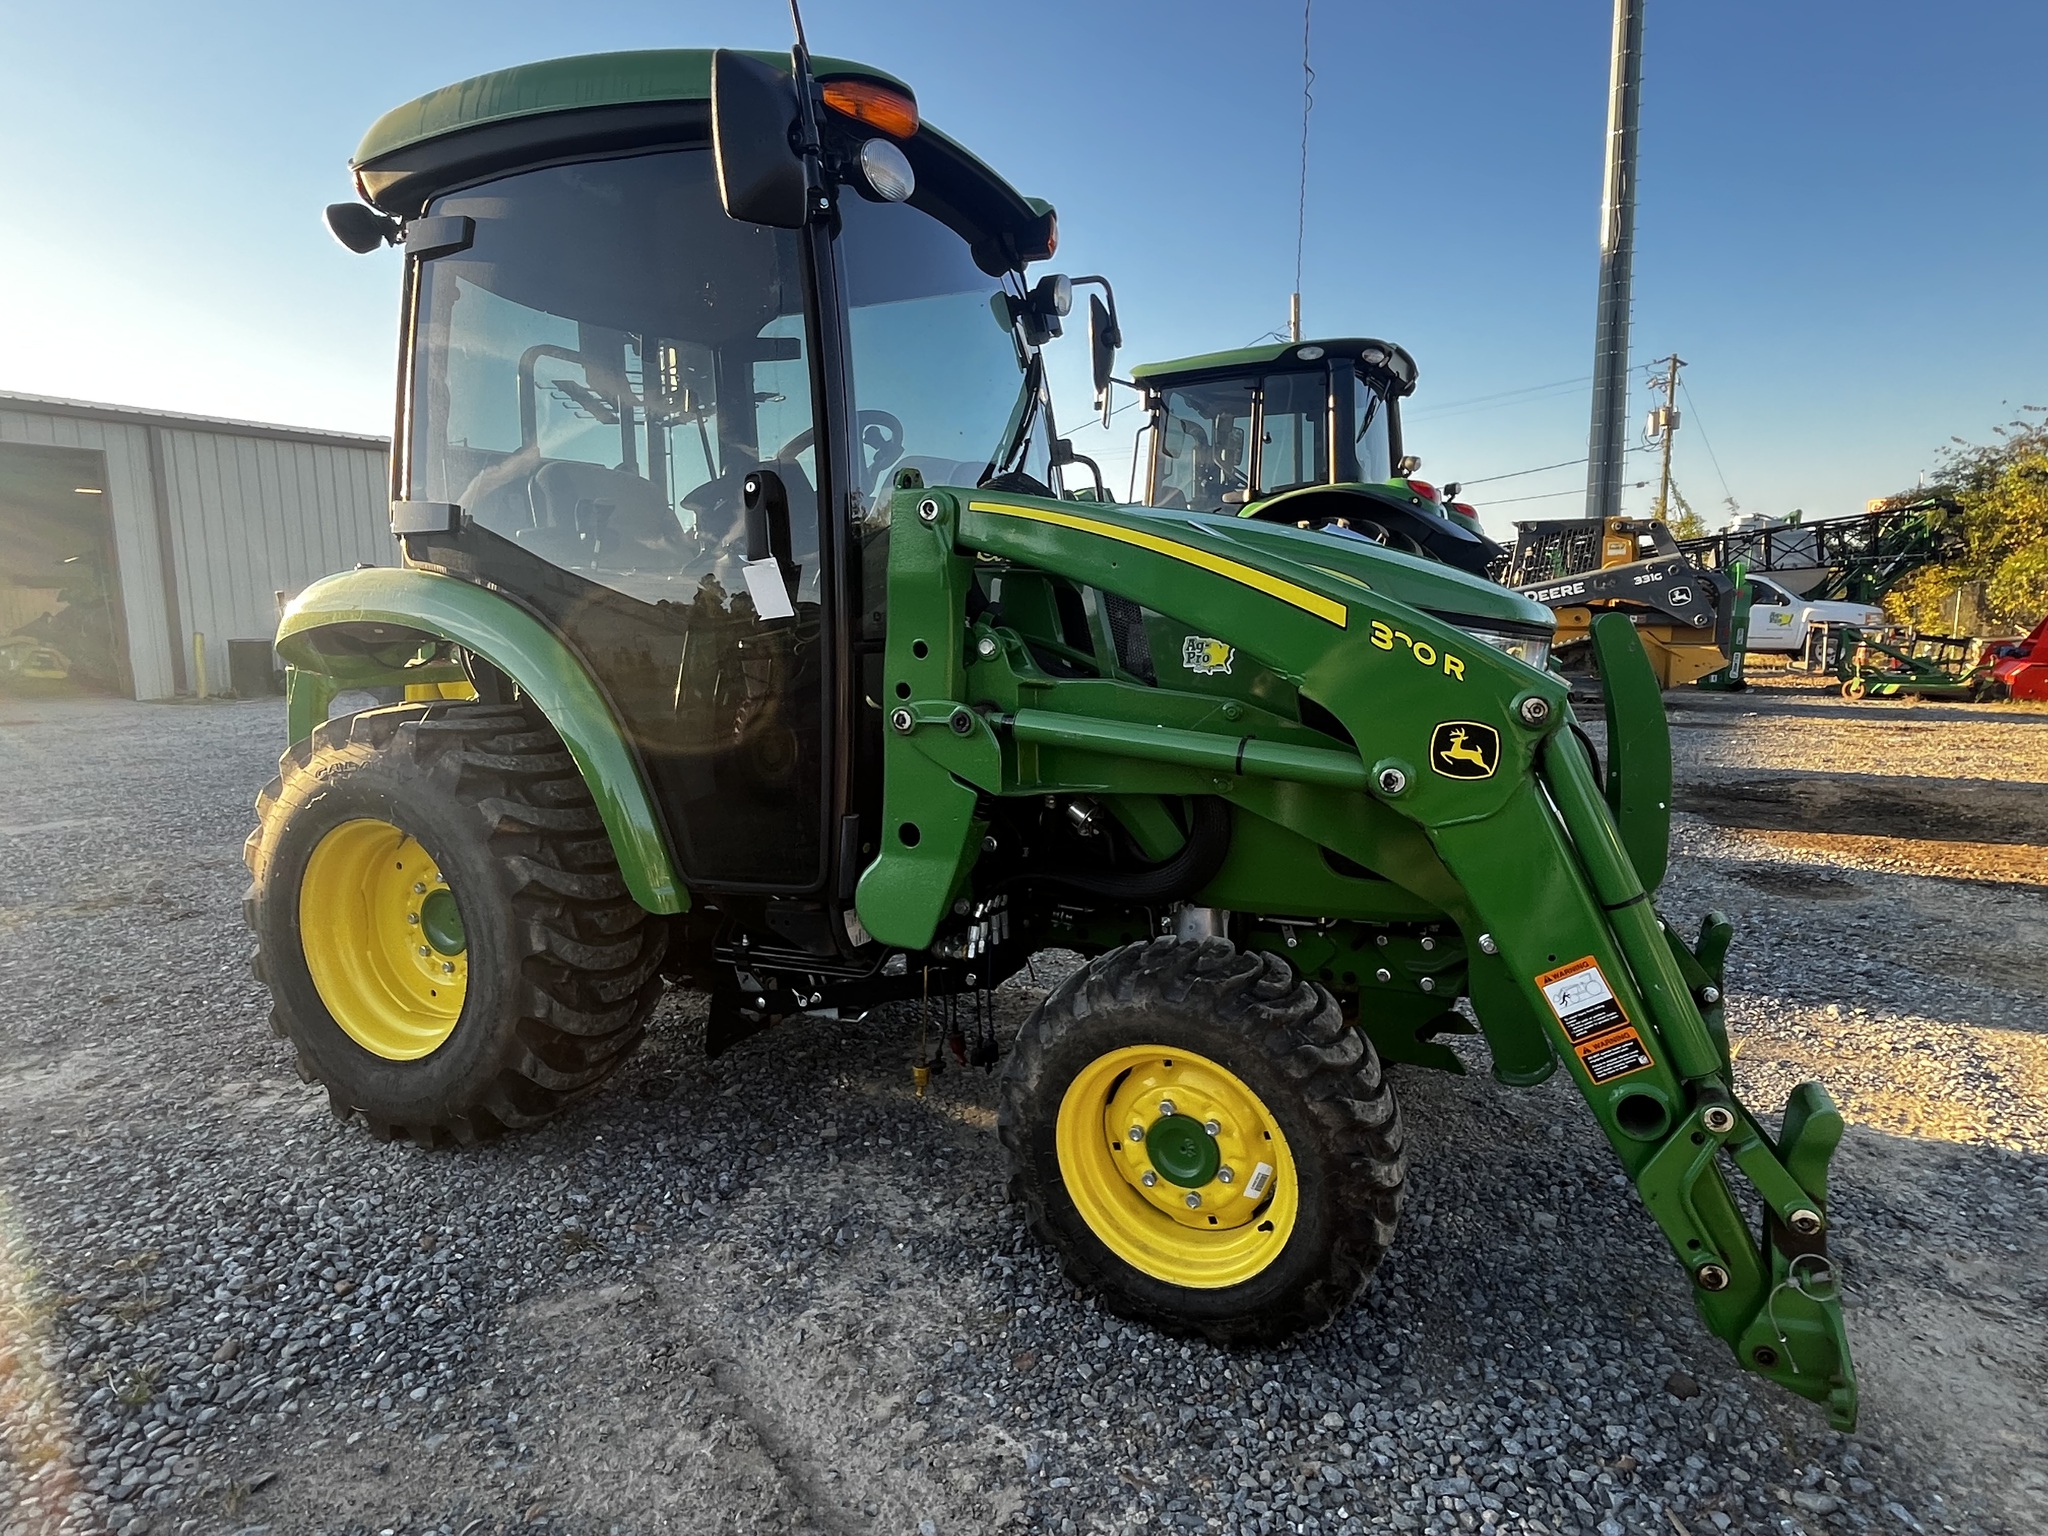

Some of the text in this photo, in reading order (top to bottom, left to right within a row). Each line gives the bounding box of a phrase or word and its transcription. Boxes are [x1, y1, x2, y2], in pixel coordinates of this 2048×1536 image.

[1633, 572, 1663, 586] 331G
[1523, 581, 1585, 602] DEERE
[1186, 651, 1210, 664] Pro
[1552, 960, 1590, 980] WARNING
[1592, 1032, 1631, 1050] WARNING
